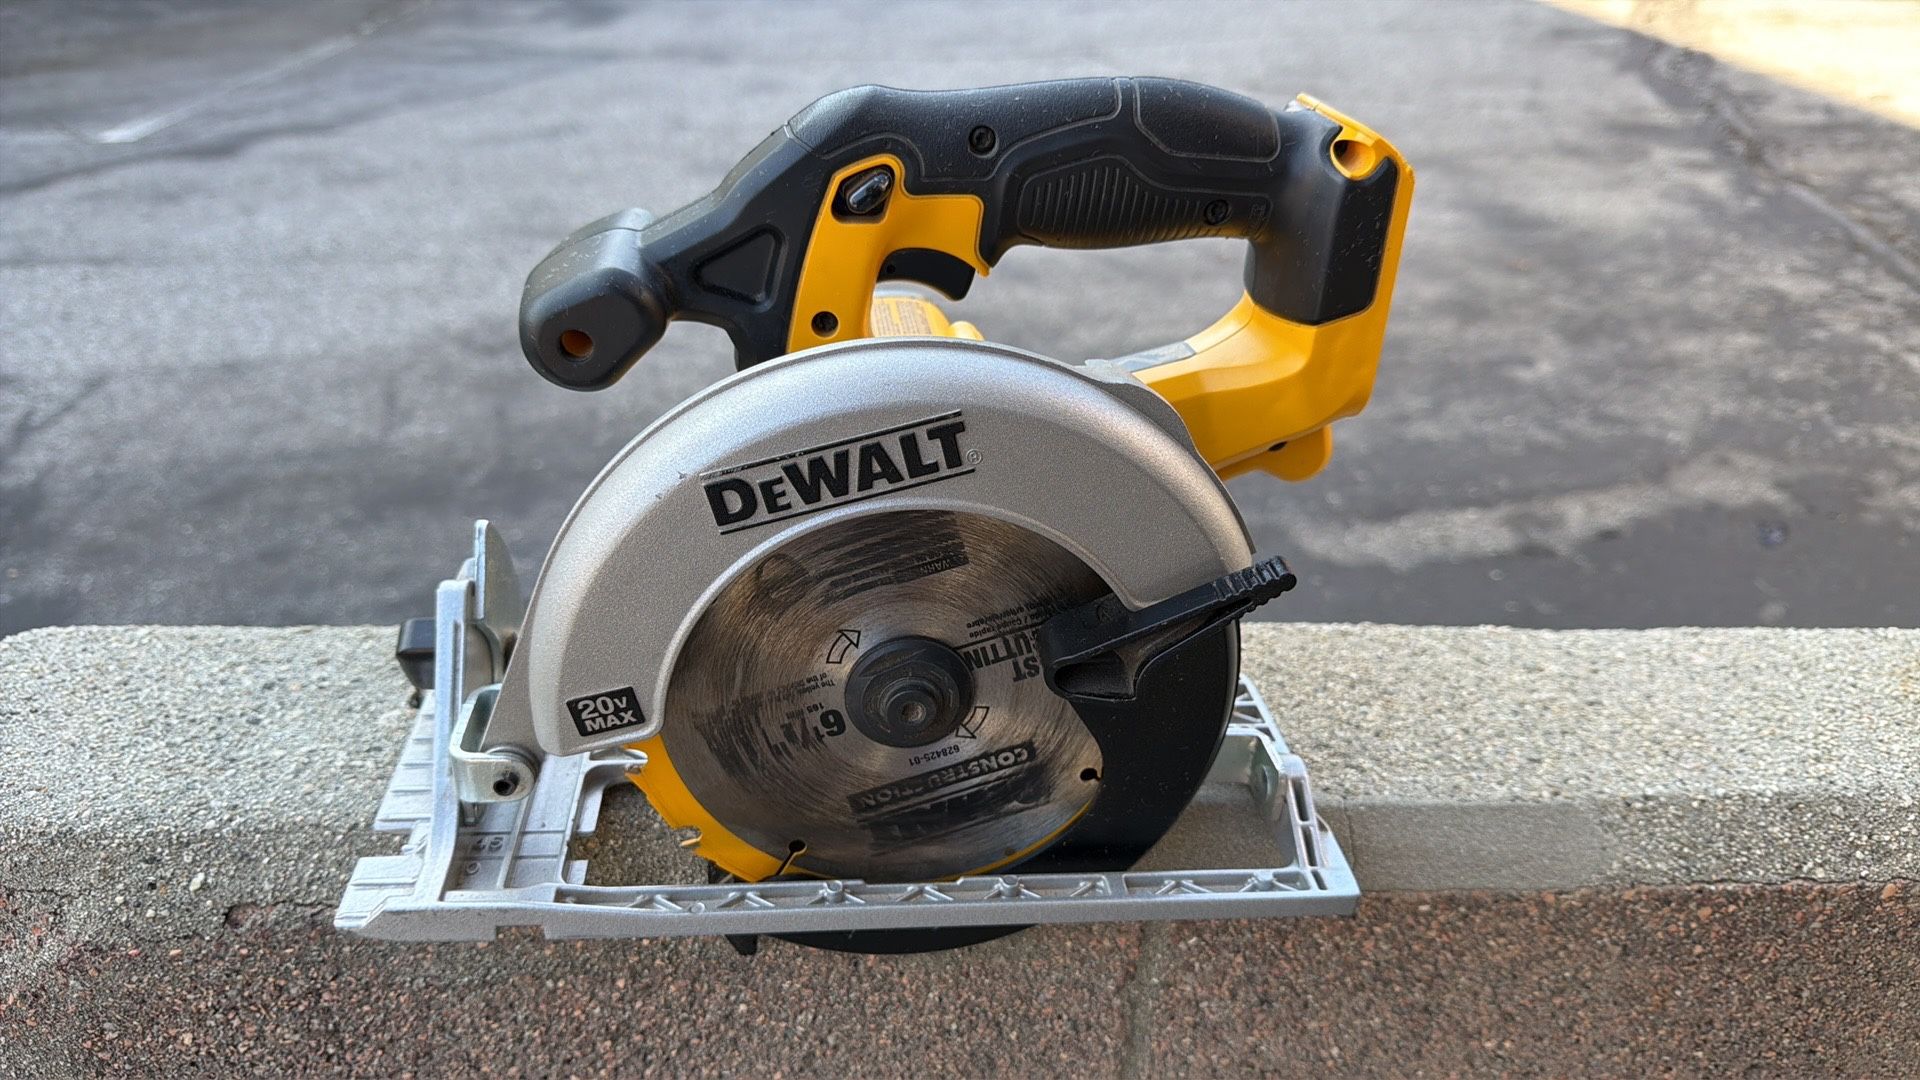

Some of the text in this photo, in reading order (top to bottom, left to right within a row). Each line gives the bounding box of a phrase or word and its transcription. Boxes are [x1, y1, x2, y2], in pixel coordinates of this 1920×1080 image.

[963, 629, 1040, 671] UTTIN
[1012, 656, 1040, 682] ST
[584, 710, 637, 732] MAX
[908, 744, 961, 767] 628425-01
[862, 747, 1029, 806] CONSTRUTION
